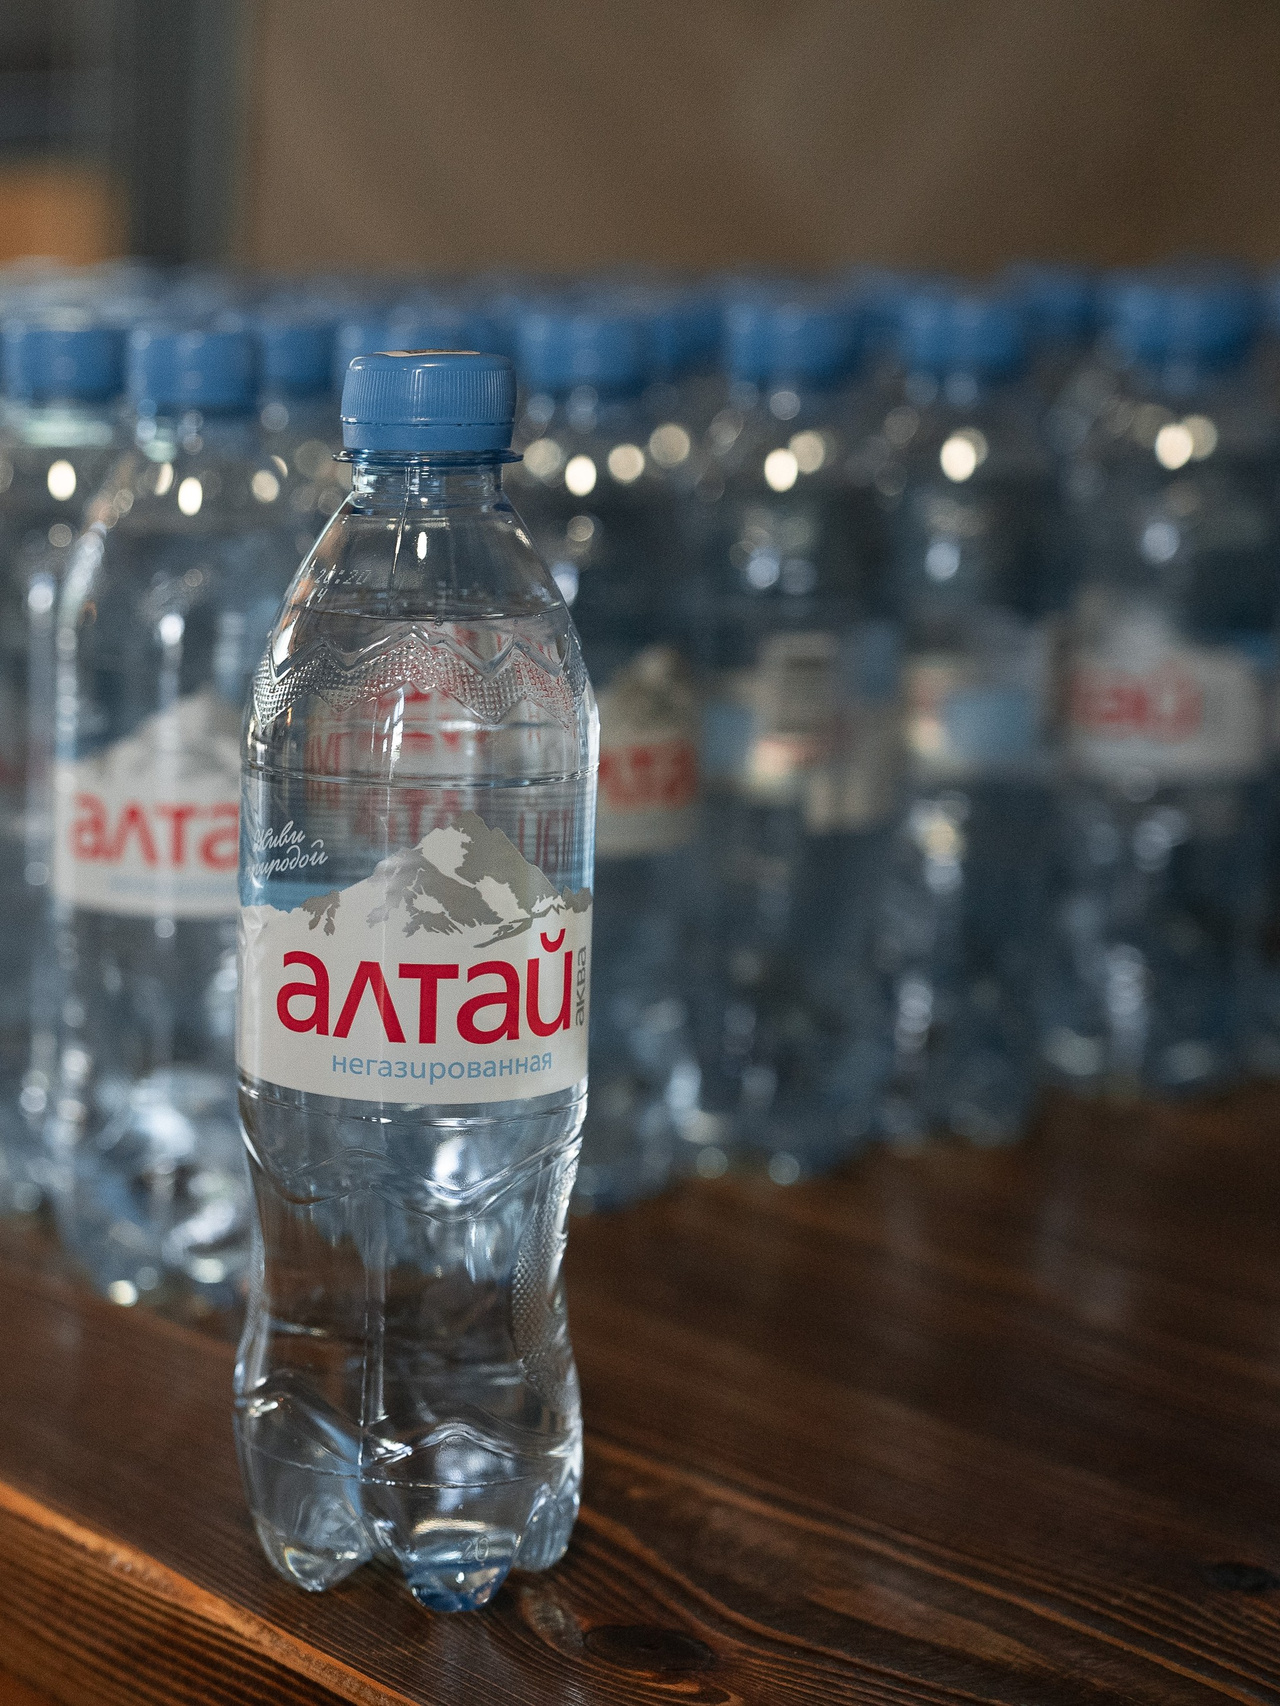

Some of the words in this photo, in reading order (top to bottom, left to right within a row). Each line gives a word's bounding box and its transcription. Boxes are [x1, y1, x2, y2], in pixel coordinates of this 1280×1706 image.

[70, 790, 239, 870] алта
[252, 820, 306, 852] Живи
[276, 928, 573, 1044] алтай
[575, 946, 587, 1027] аква
[332, 1052, 552, 1085] негазированная
